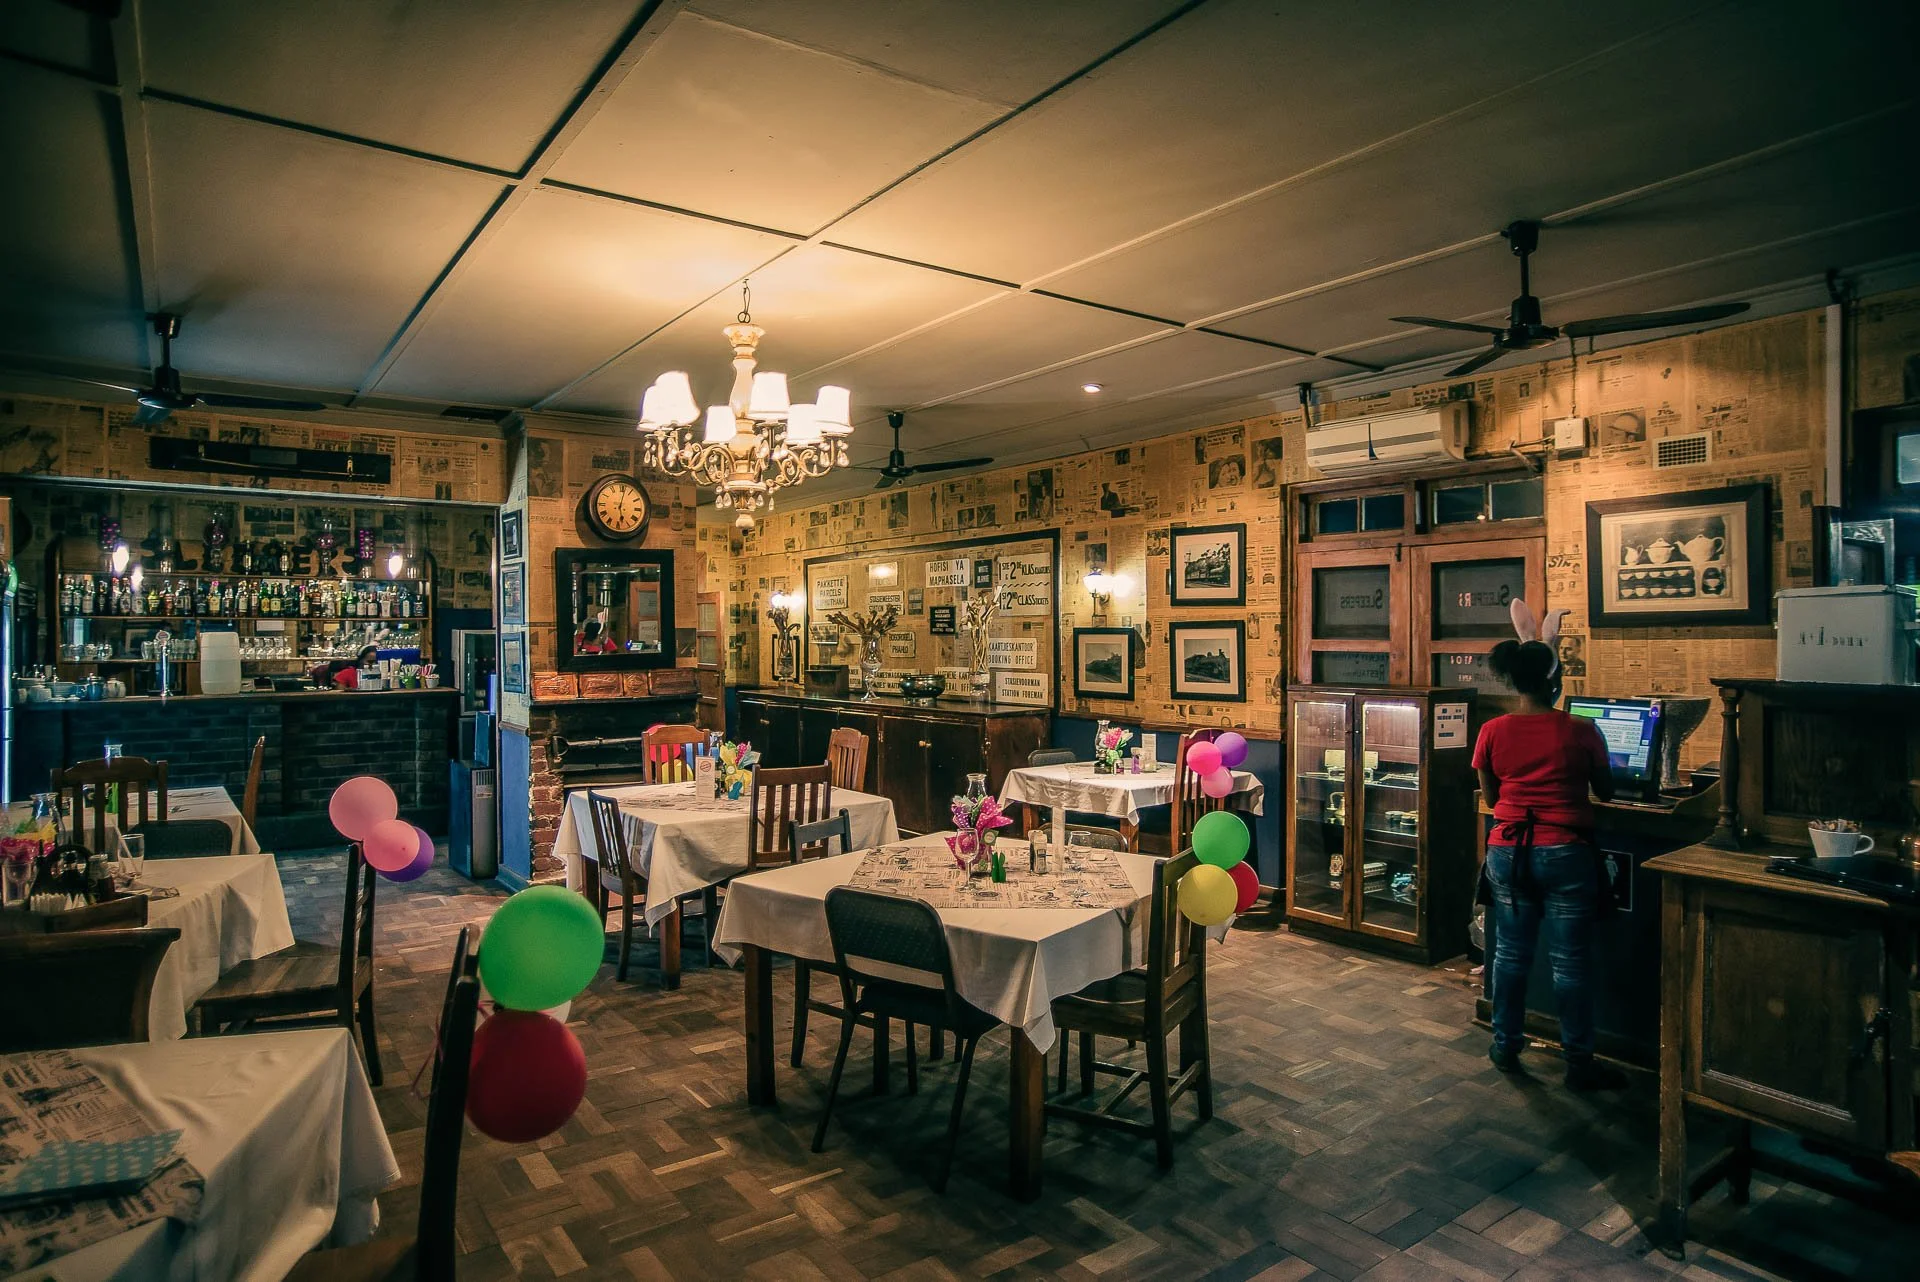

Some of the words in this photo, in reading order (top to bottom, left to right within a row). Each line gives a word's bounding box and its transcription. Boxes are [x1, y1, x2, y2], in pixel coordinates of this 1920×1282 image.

[929, 561, 949, 573] HOFISI
[955, 560, 965, 571] YA
[929, 574, 965, 586] MAPHASELA
[1017, 594, 1035, 606] CLASS
[988, 654, 1012, 665] BOOKING
[1015, 655, 1034, 665] OFFICE
[1001, 688, 1020, 698] STATION
